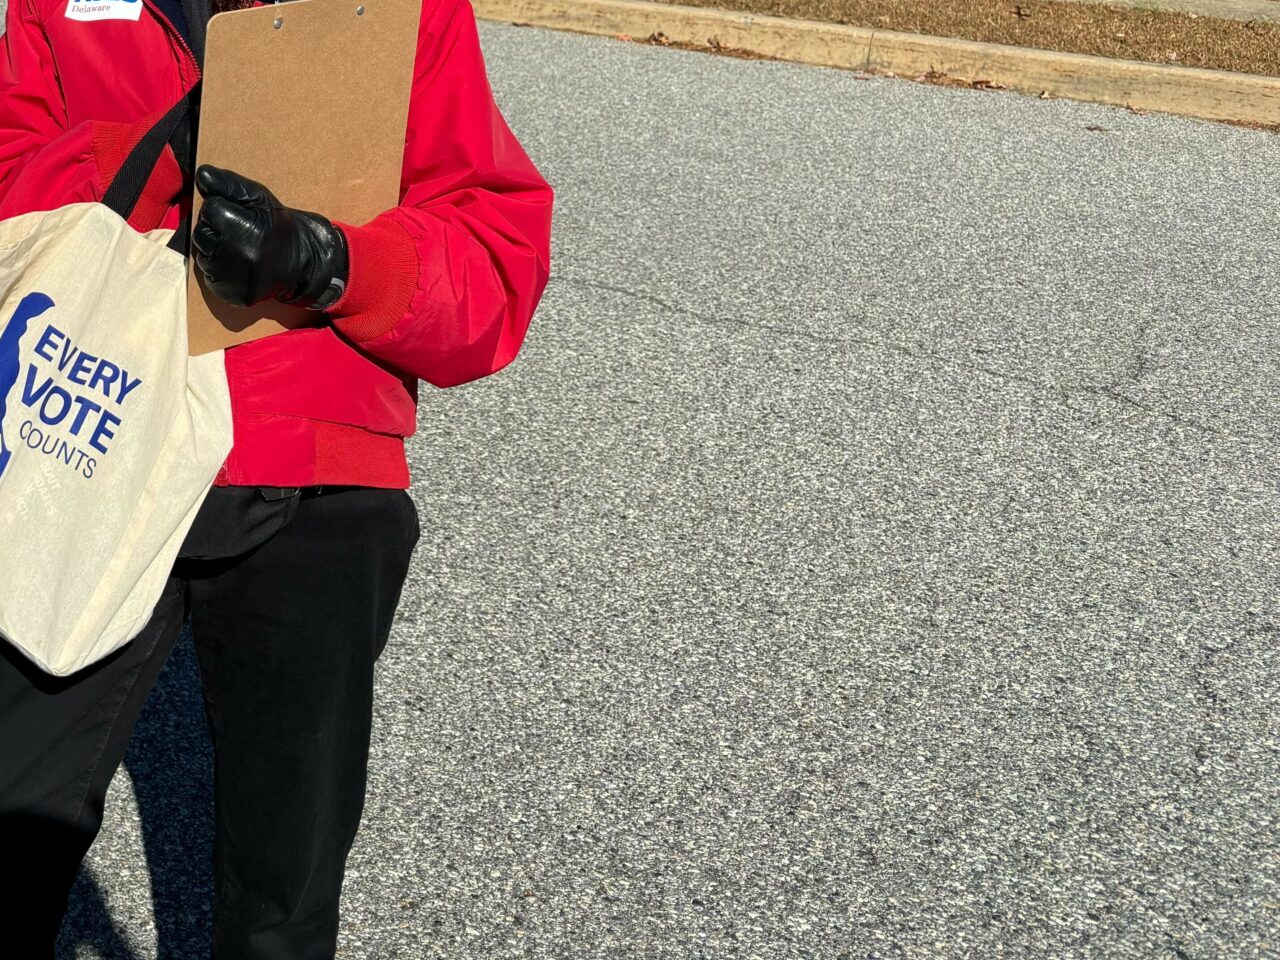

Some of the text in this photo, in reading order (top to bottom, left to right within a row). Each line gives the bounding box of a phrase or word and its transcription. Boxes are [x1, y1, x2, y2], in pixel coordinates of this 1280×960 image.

[71, 3, 112, 14] Delaware
[34, 324, 142, 405] EVERY
[21, 362, 122, 455] VOTE
[19, 420, 97, 479] COUNTS
